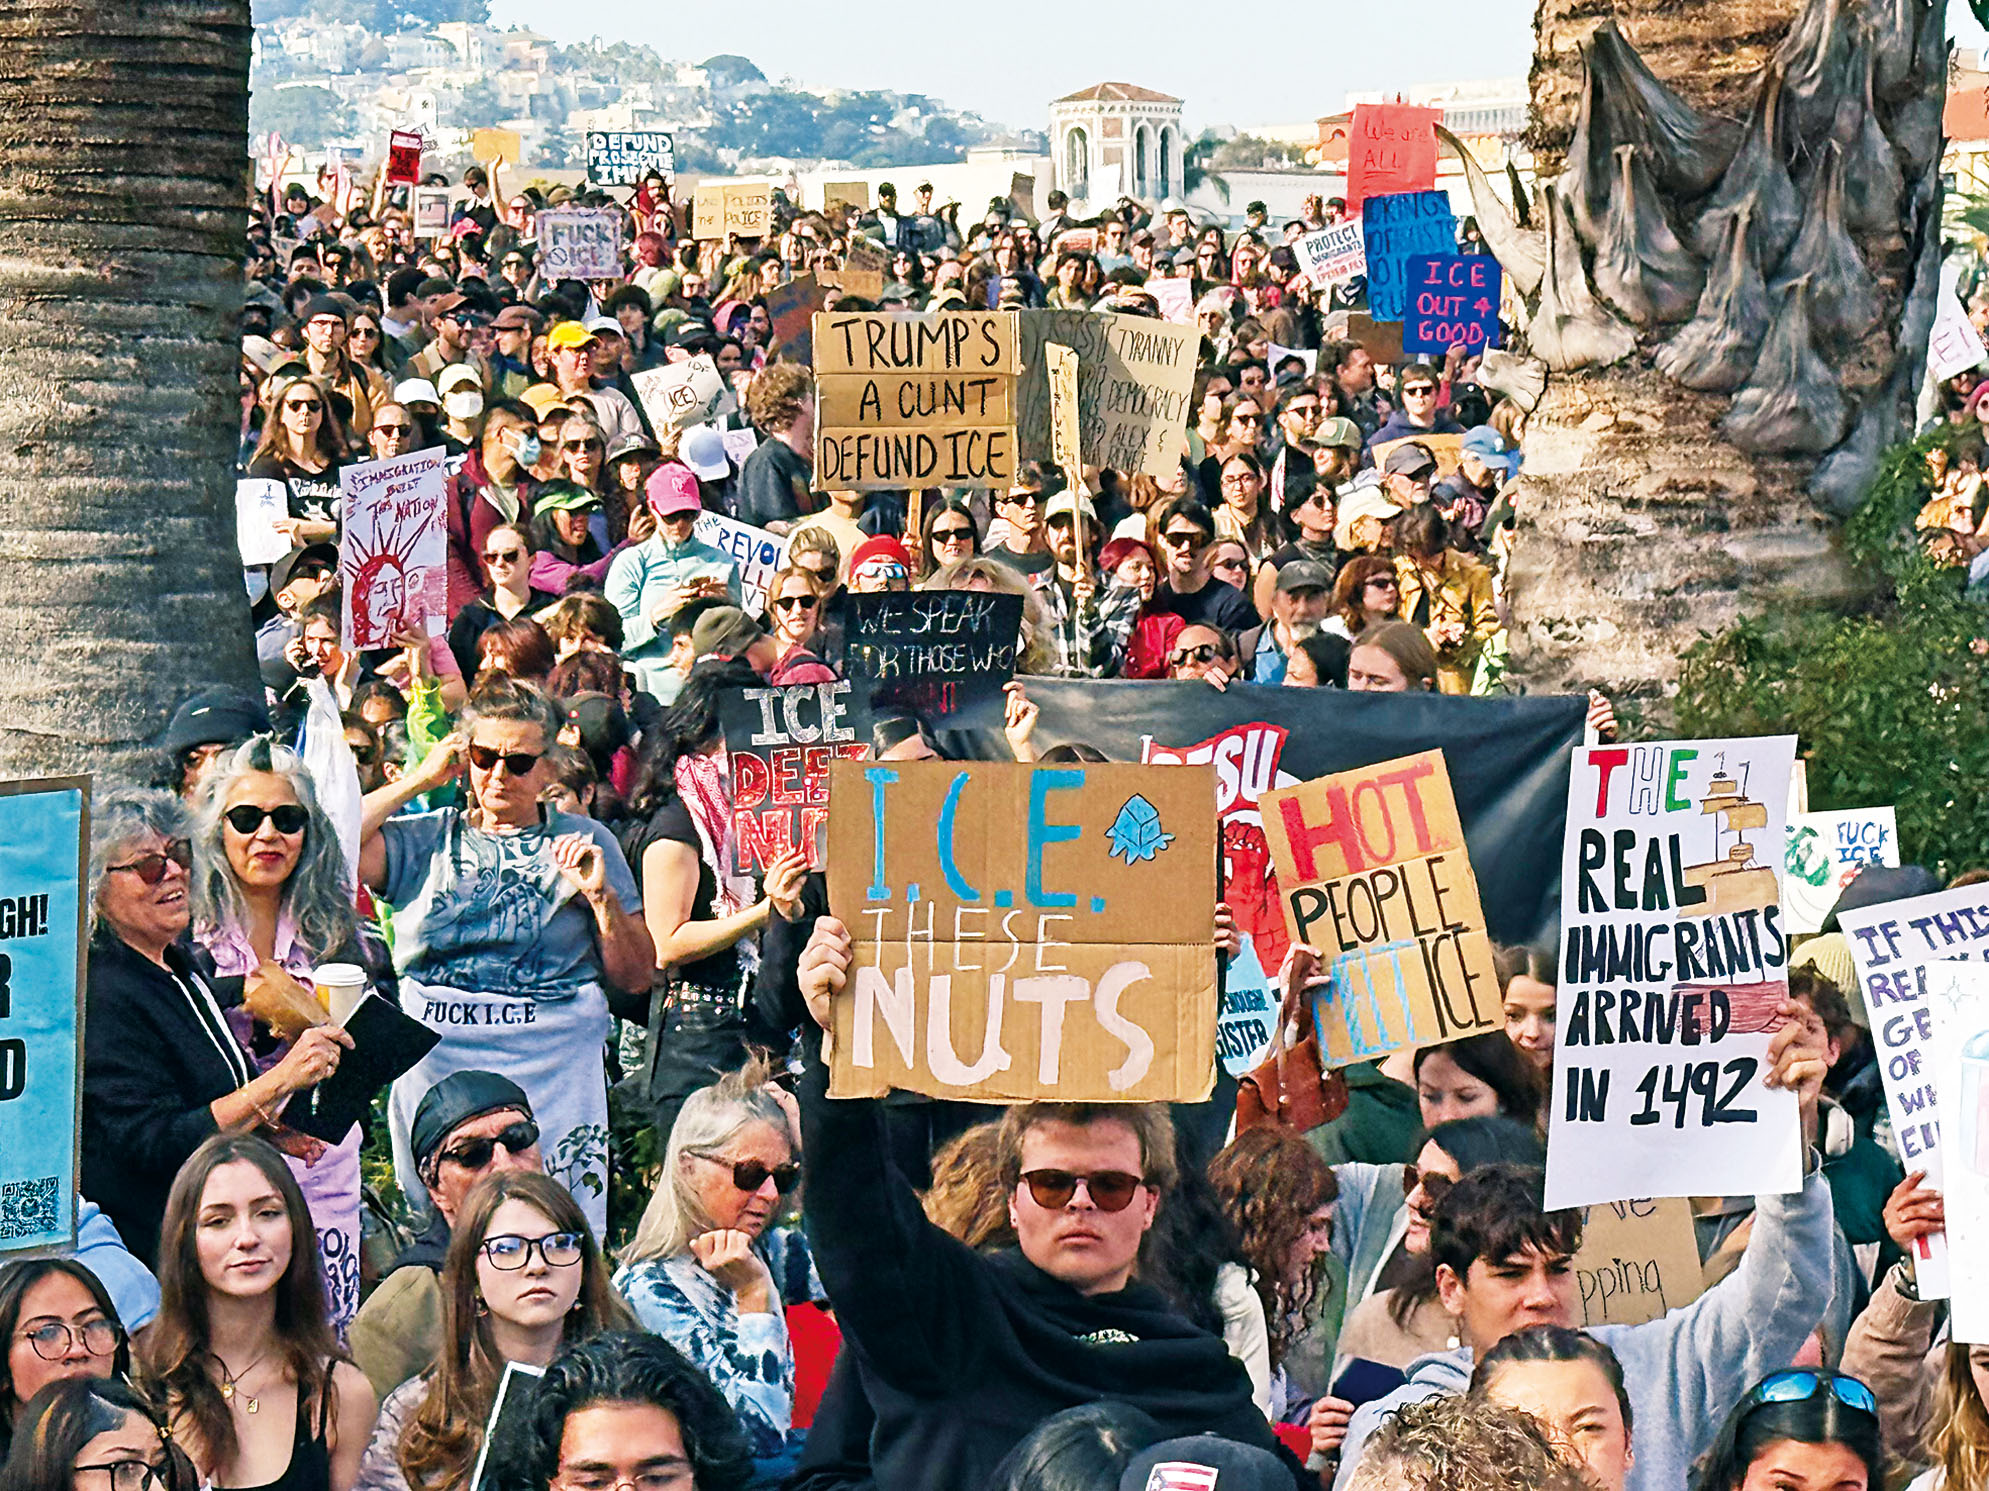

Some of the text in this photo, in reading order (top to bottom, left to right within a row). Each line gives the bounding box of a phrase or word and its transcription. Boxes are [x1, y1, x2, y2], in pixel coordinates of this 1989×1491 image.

[591, 133, 672, 153] DEFUND
[551, 222, 612, 246] FUCK
[1306, 224, 1357, 255] PROTECT
[1423, 261, 1486, 288] ICE
[1416, 292, 1467, 316] OUT
[832, 318, 999, 369] TRUMP'S
[1119, 328, 1184, 368] TYRANNY
[1418, 320, 1484, 345] GOOD
[860, 378, 999, 421] A CUNT
[823, 431, 1007, 482] DEFUND ICE
[1110, 422, 1151, 450] ALEX
[394, 495, 439, 523] NATION
[696, 516, 721, 534] THE
[857, 595, 996, 635] WE SPEAK
[903, 643, 966, 675] THOSE
[970, 643, 1014, 673] WHO
[743, 680, 855, 746] ICE
[731, 743, 870, 809] DEE
[1588, 747, 1699, 819] THE
[1279, 761, 1435, 882] HOT
[1837, 821, 1890, 848] FUCK
[1578, 829, 1706, 914] REAL
[1835, 845, 1885, 864] ICE
[1290, 856, 1464, 952] PEOPLE
[861, 900, 1073, 973] THESE
[1565, 906, 1786, 985] IMMIGRANTS
[1853, 920, 1902, 968] IF
[1419, 931, 1495, 1039] ICE
[422, 1001, 479, 1025] FUCK
[851, 961, 1155, 1092] NUTS
[1563, 988, 1731, 1048] ARRIVED
[1565, 1054, 1758, 1129] IN 1492
[1575, 1257, 1668, 1327] pping
